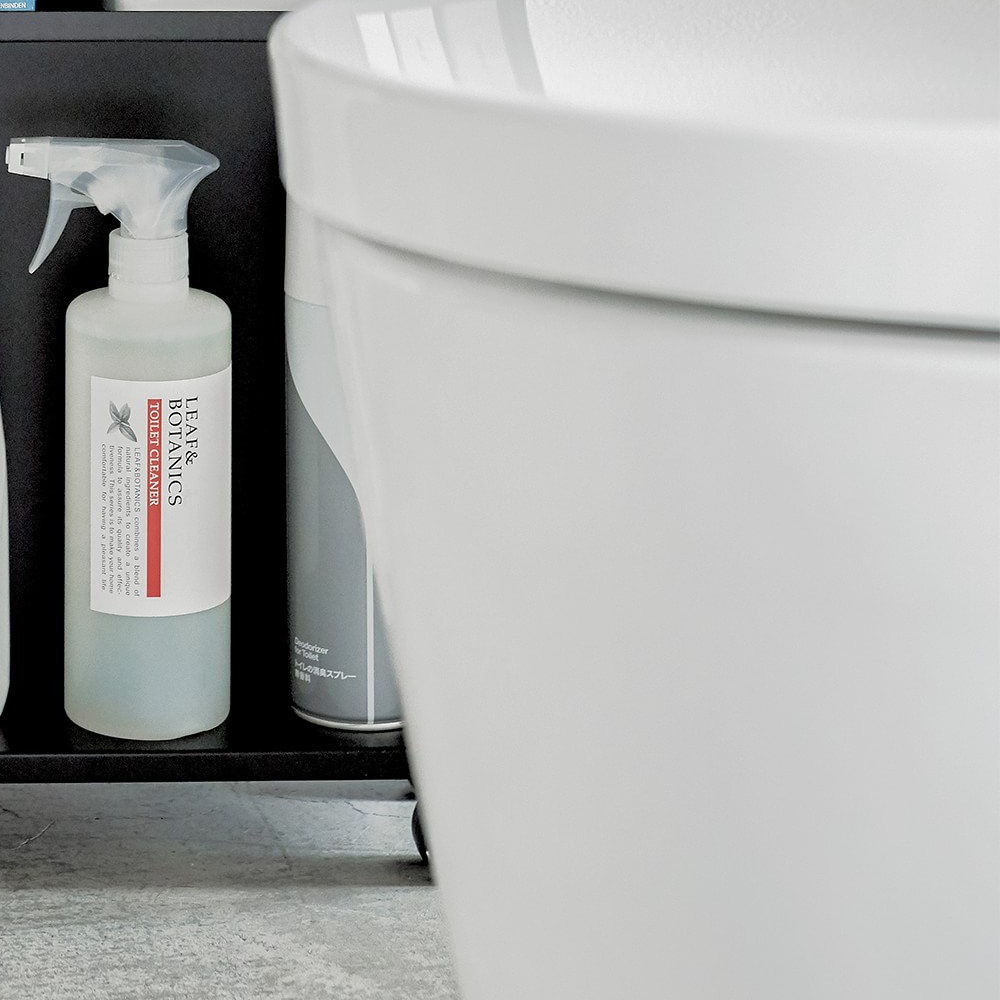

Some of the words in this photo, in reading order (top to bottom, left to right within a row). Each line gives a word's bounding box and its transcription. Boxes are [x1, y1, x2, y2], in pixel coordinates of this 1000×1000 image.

[149, 402, 159, 446] TOILET
[185, 396, 199, 465] LEAF&
[168, 398, 183, 506] BOTANICS
[149, 449, 159, 506] CLEANER
[134, 589, 140, 597] of
[302, 649, 319, 661] Toilet
